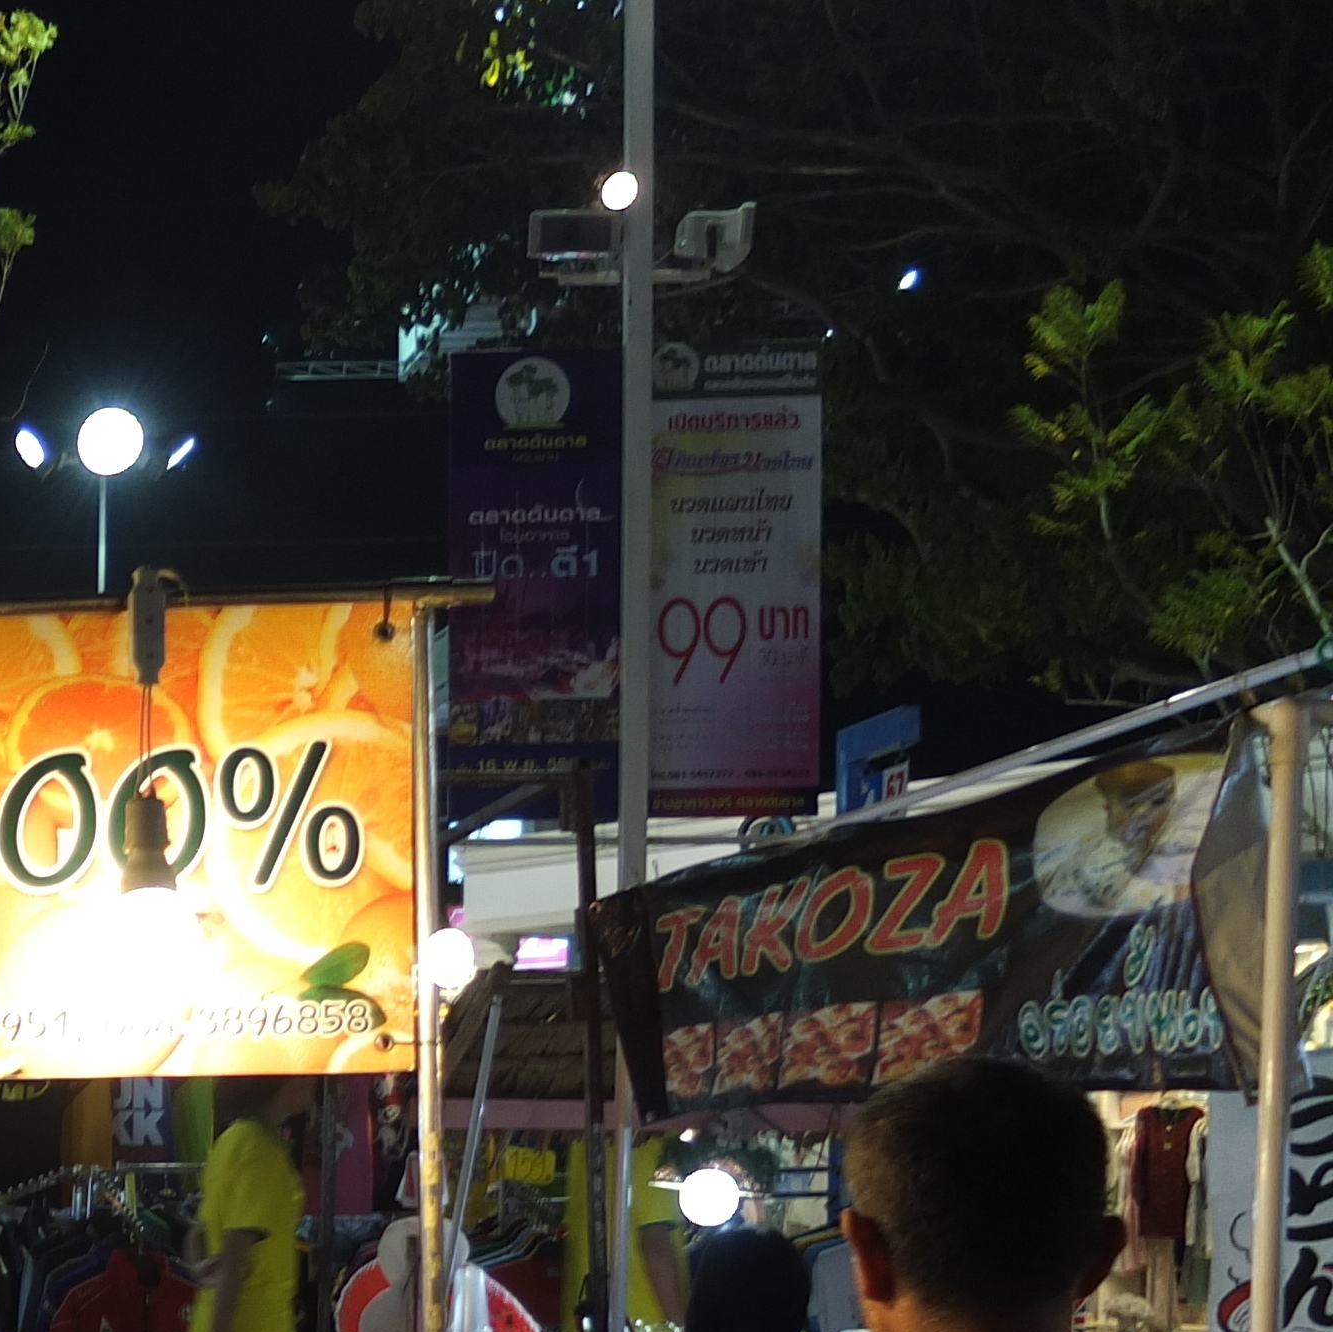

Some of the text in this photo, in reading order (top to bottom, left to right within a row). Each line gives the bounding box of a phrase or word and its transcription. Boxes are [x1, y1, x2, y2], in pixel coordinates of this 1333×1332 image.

[658, 597, 810, 685] 99 บาท
[656, 838, 1009, 993] TAKOZA
